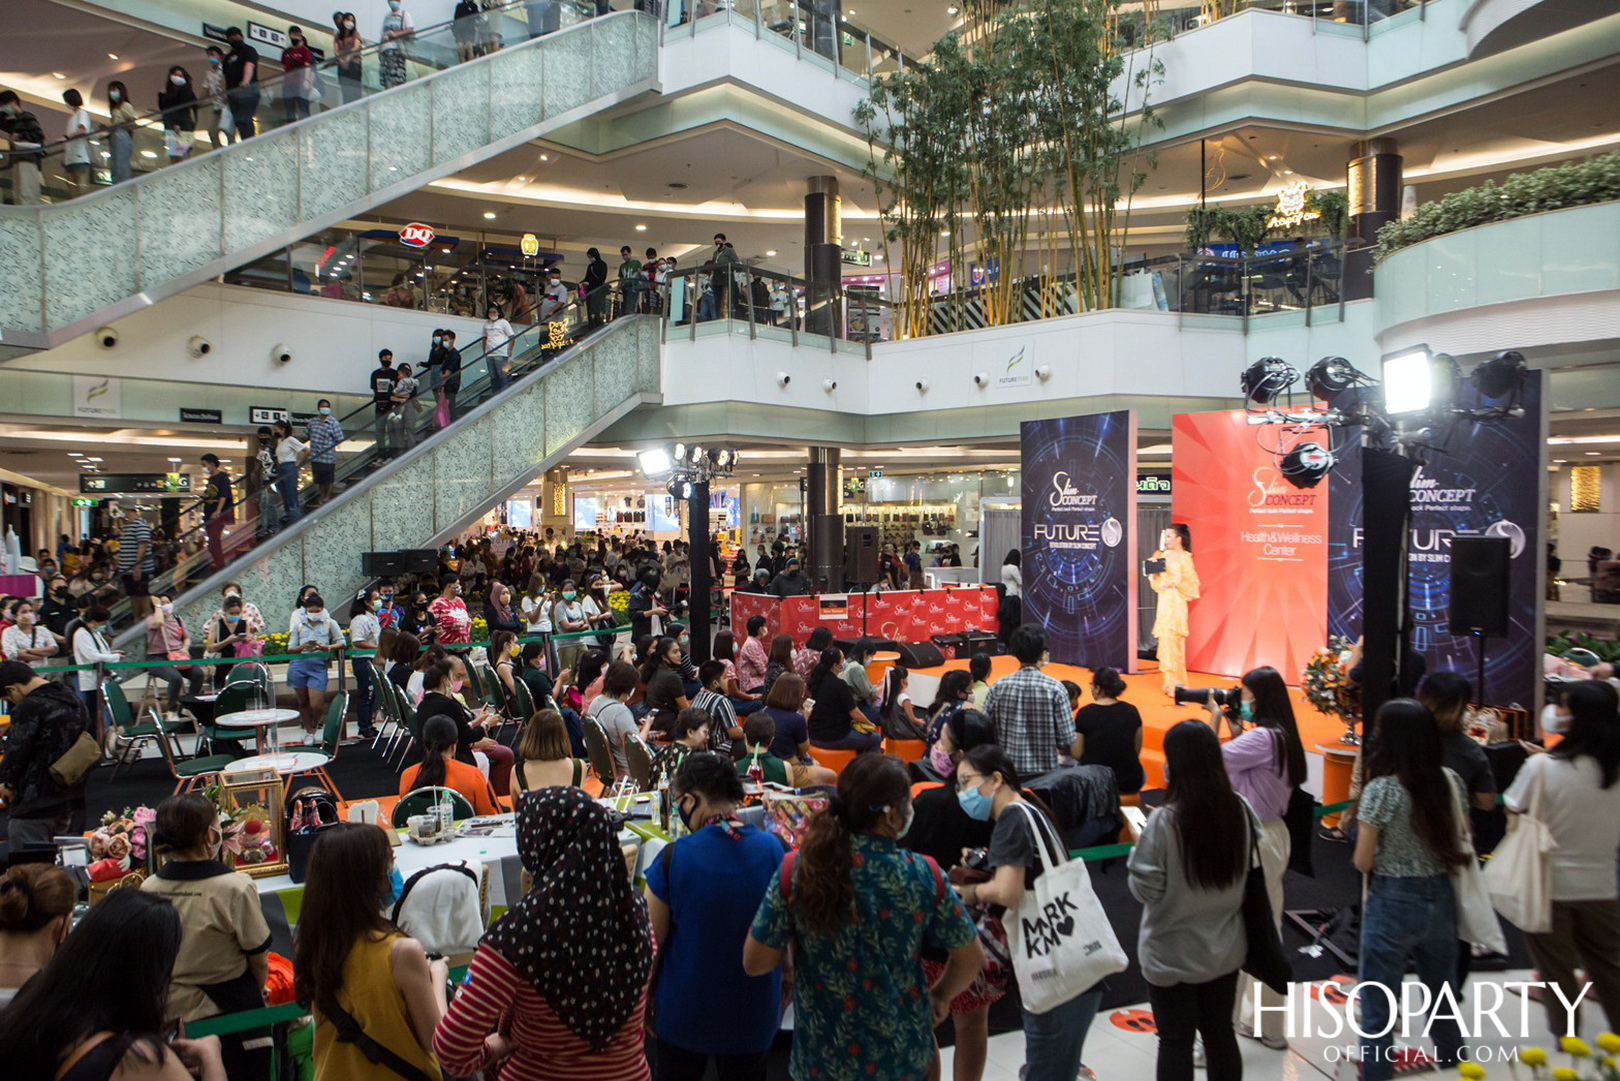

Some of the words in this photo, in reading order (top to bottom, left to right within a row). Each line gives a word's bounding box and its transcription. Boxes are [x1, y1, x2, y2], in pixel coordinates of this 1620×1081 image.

[405, 228, 431, 242] DQ
[1409, 465, 1439, 489] lim
[1049, 471, 1079, 507] Slim
[1248, 467, 1288, 507] Slim
[1061, 495, 1098, 505] CONCEPT
[1265, 494, 1317, 506] CONCEPT
[1034, 524, 1100, 541] FUTURE
[1263, 543, 1296, 556] Center
